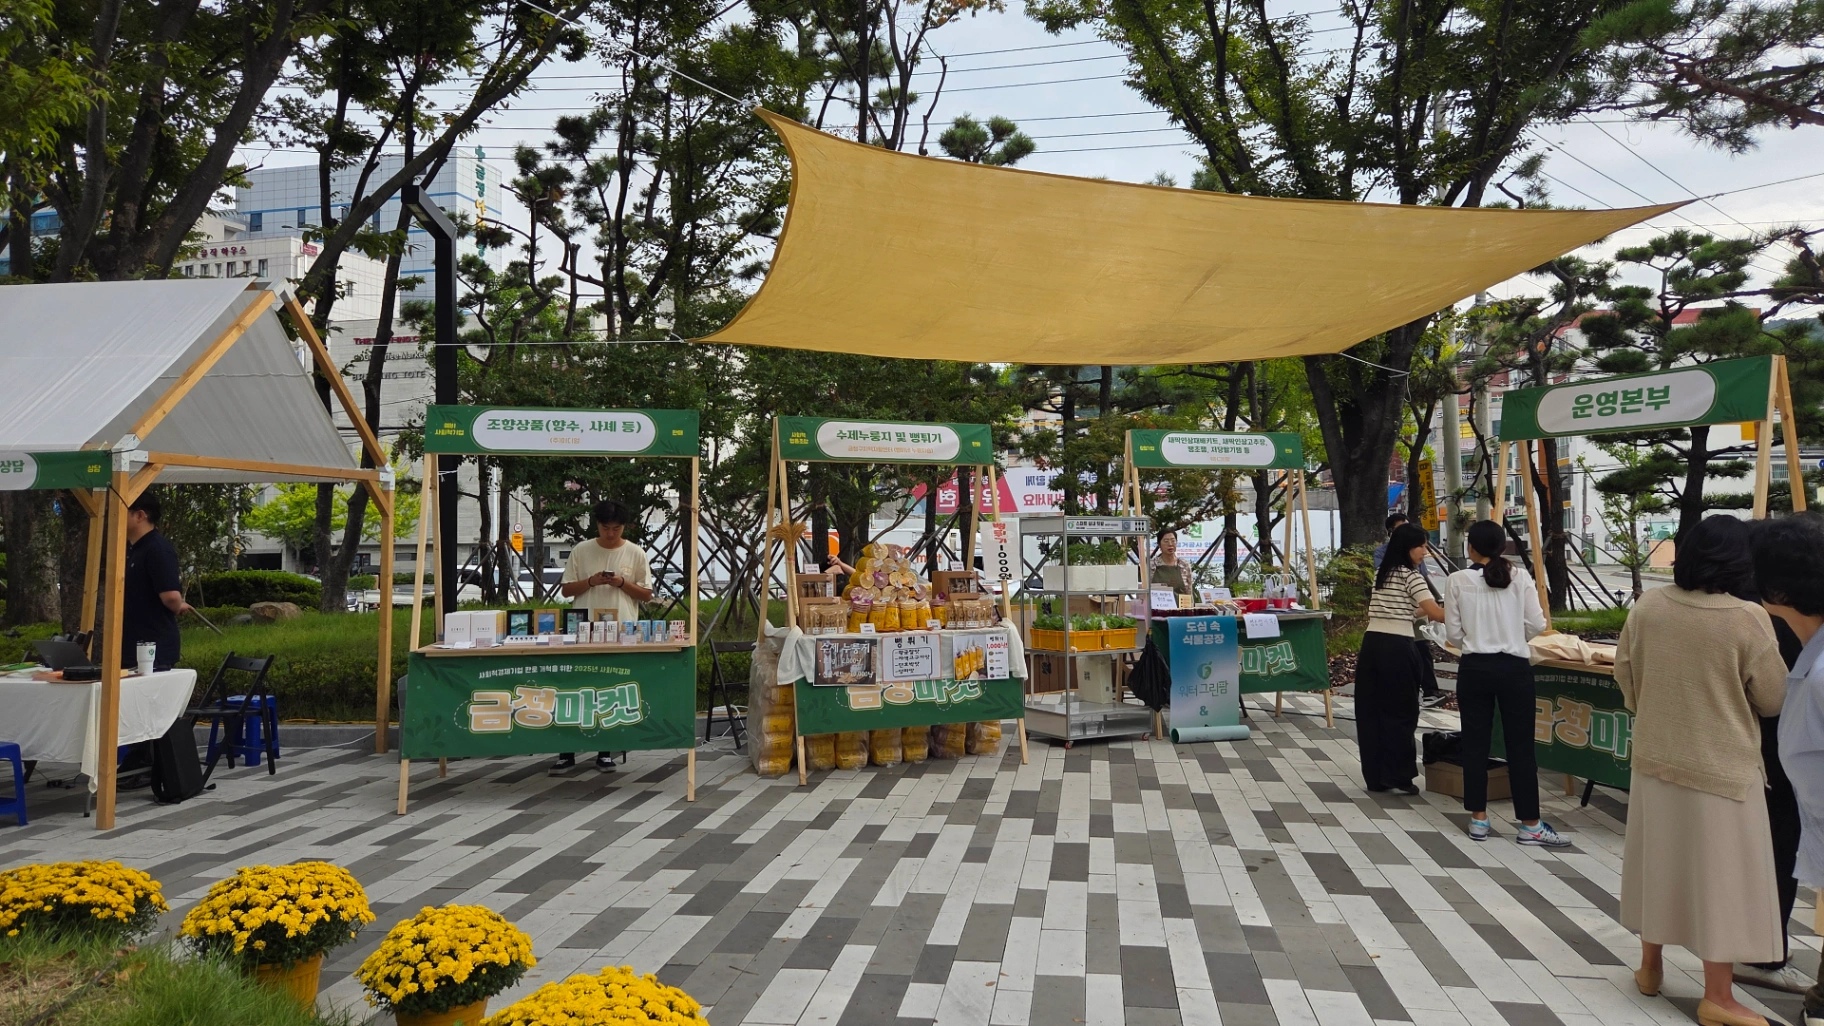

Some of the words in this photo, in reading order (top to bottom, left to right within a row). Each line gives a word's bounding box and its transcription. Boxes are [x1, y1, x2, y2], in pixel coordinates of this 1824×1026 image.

[1572, 385, 1671, 420] 운영본부
[486, 418, 584, 434] 조향상품(향수,
[621, 420, 642, 434] 등)
[836, 429, 892, 442] 수제누룽지
[895, 431, 906, 443] 및
[909, 432, 942, 444] 뻥튀기
[1186, 620, 1208, 634] 도심
[1210, 621, 1221, 633] 속
[1183, 633, 1225, 646] 식물공장
[820, 642, 839, 654] 수제
[841, 642, 870, 655] 누룽지
[1238, 641, 1297, 675] 마켓
[478, 667, 524, 679] 사회적경제기업
[525, 666, 538, 675] 판로
[539, 665, 559, 674] 개척을
[559, 664, 573, 673] 위한
[574, 664, 599, 674] 2025년
[599, 666, 631, 676] 사회적경제
[469, 682, 643, 733] 금정마켓
